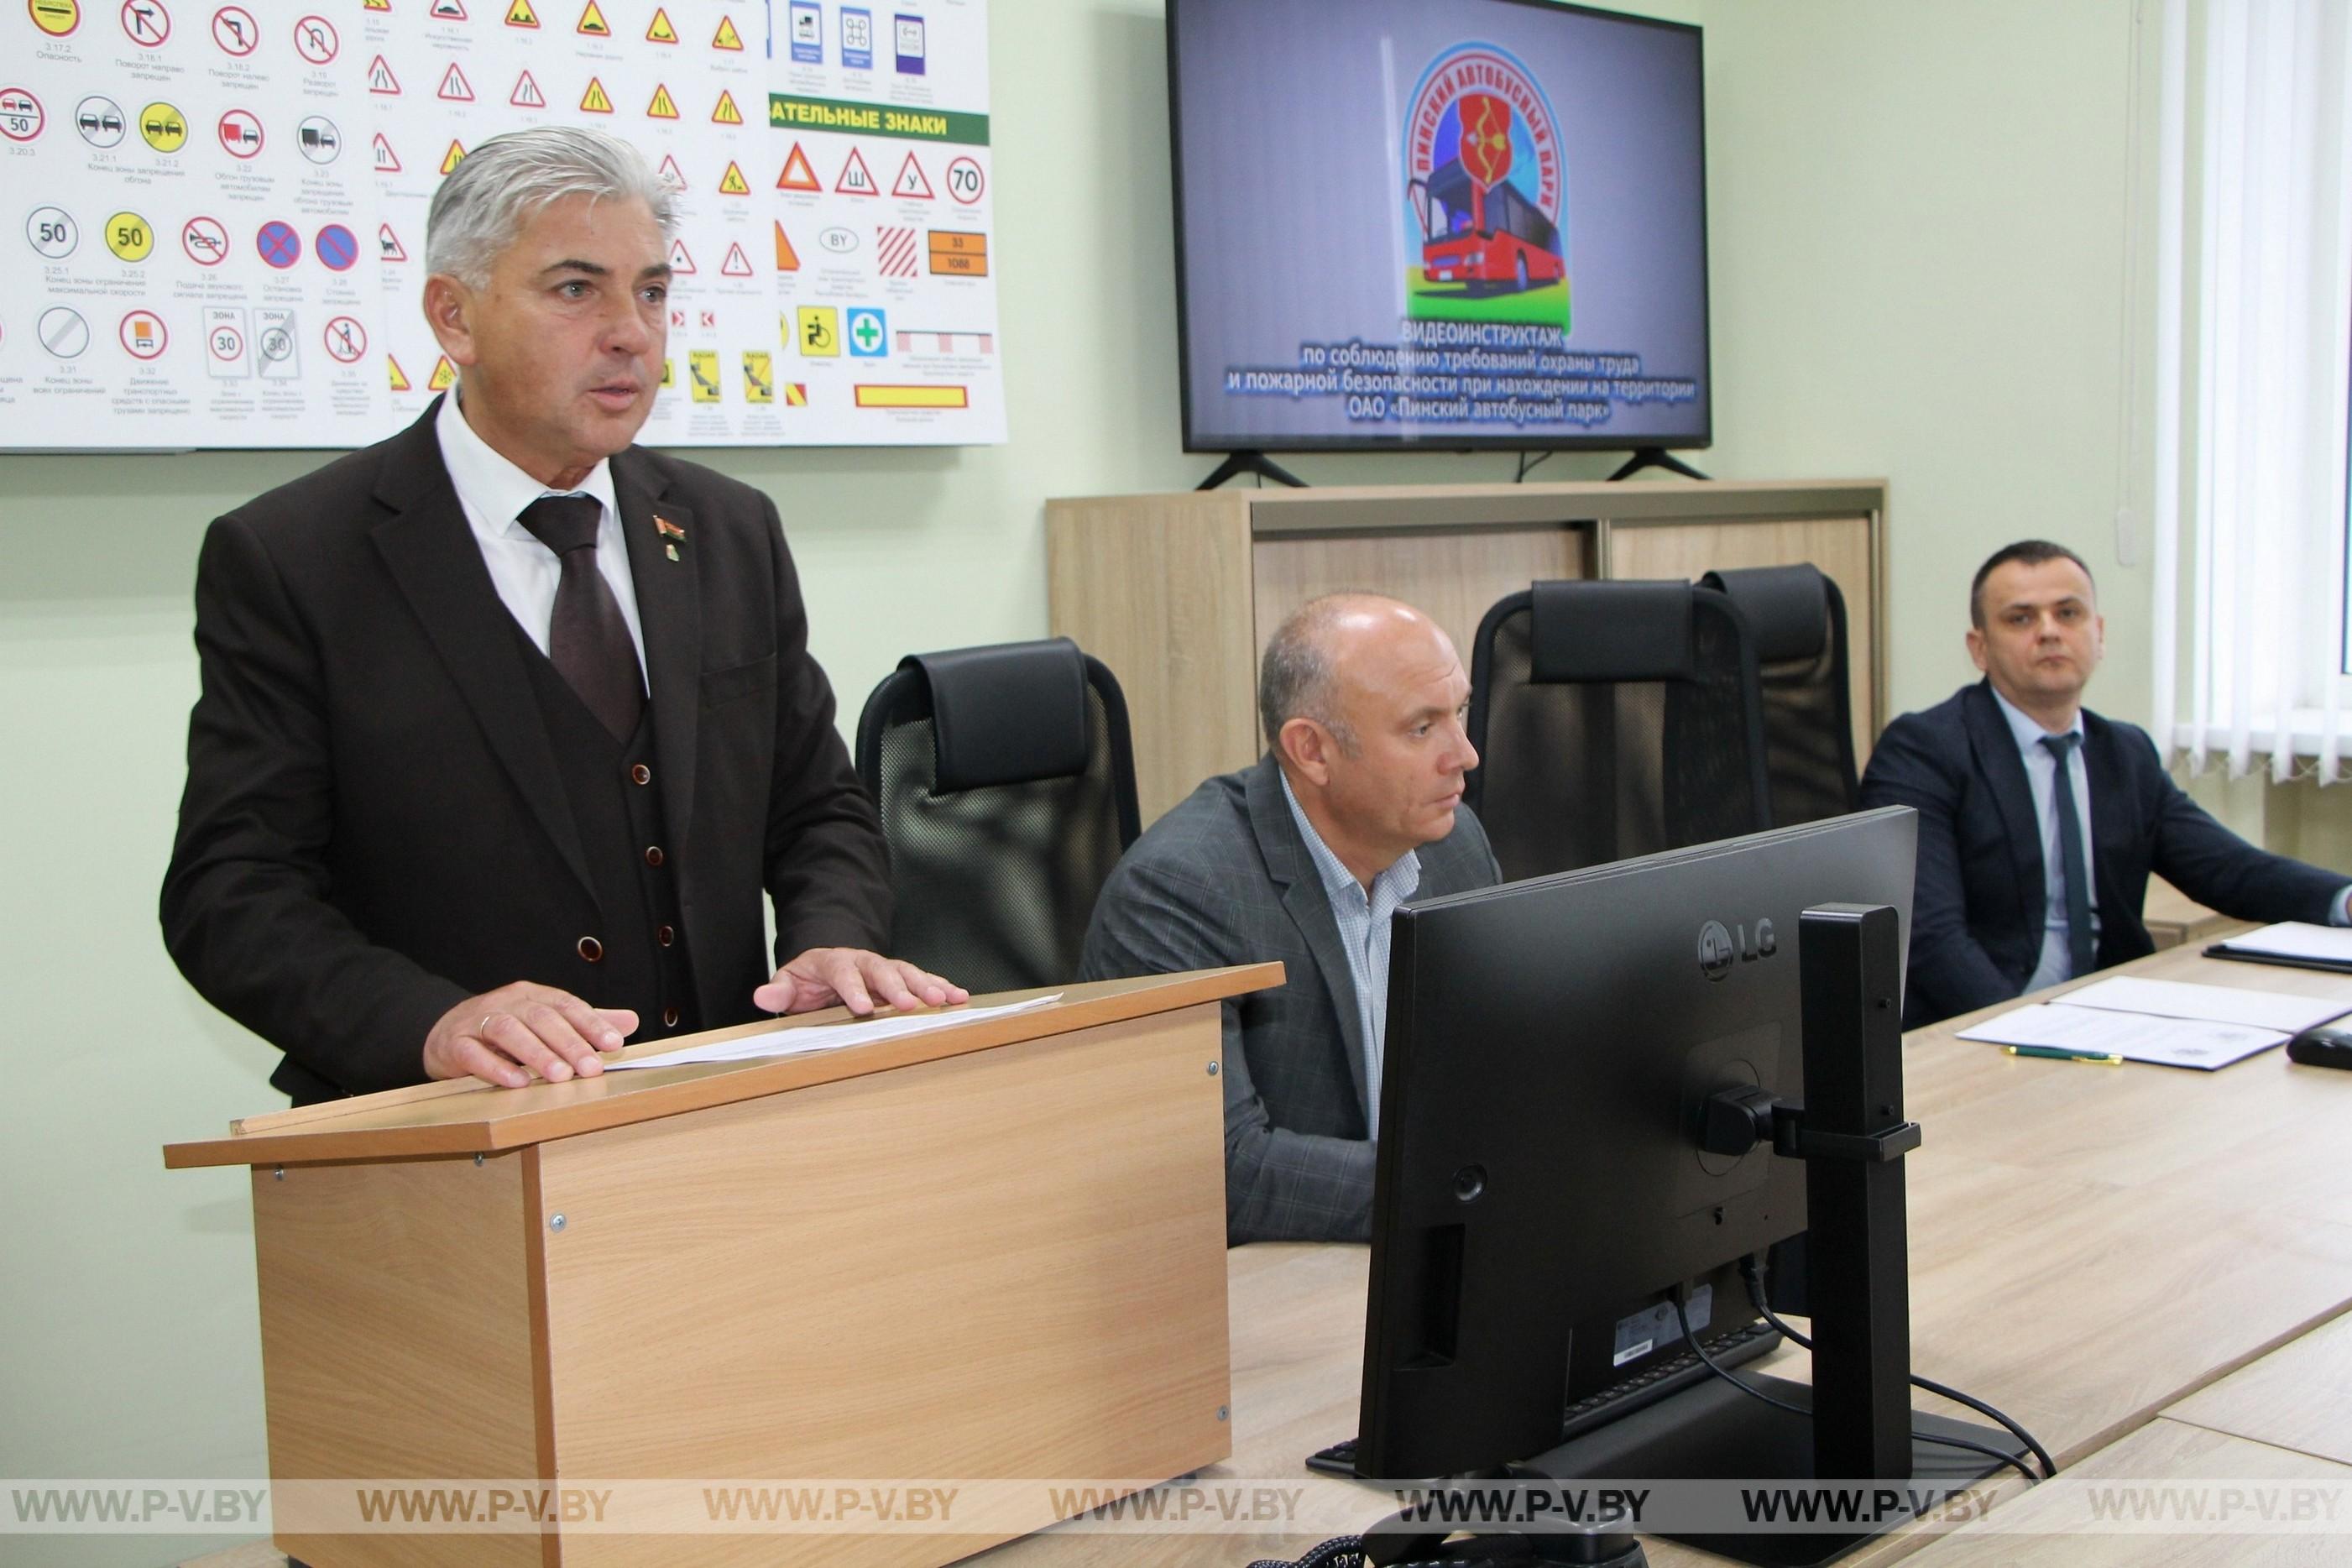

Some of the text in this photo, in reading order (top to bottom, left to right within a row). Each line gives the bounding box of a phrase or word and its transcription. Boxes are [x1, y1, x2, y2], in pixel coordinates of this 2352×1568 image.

[36, 50, 82, 63] Опасность
[10, 118, 29, 132] 50
[886, 112, 947, 135] ЗНАКИ
[1417, 65, 1555, 206] ПИНСКИЙ АВТОБУСНЫЙ ПАРК
[848, 171, 865, 187] Ш
[954, 170, 978, 191] 70
[40, 223, 66, 243] 50
[118, 227, 143, 246] 50
[831, 234, 847, 247] BY
[213, 311, 235, 320] ЗОНА
[263, 311, 285, 321] ЗОНА
[217, 337, 235, 351] 30
[269, 337, 285, 351] 30
[1402, 321, 1563, 348] ВИДЕОИНСТРУКТАЖ
[1304, 343, 1639, 377] по соблюдению требований охраны труда
[1229, 368, 1695, 400] и пожарной безопасности при нахождении на территории
[1349, 396, 1386, 417] ОАО
[1474, 397, 1564, 423] автобусный
[1738, 917, 1776, 962] LG
